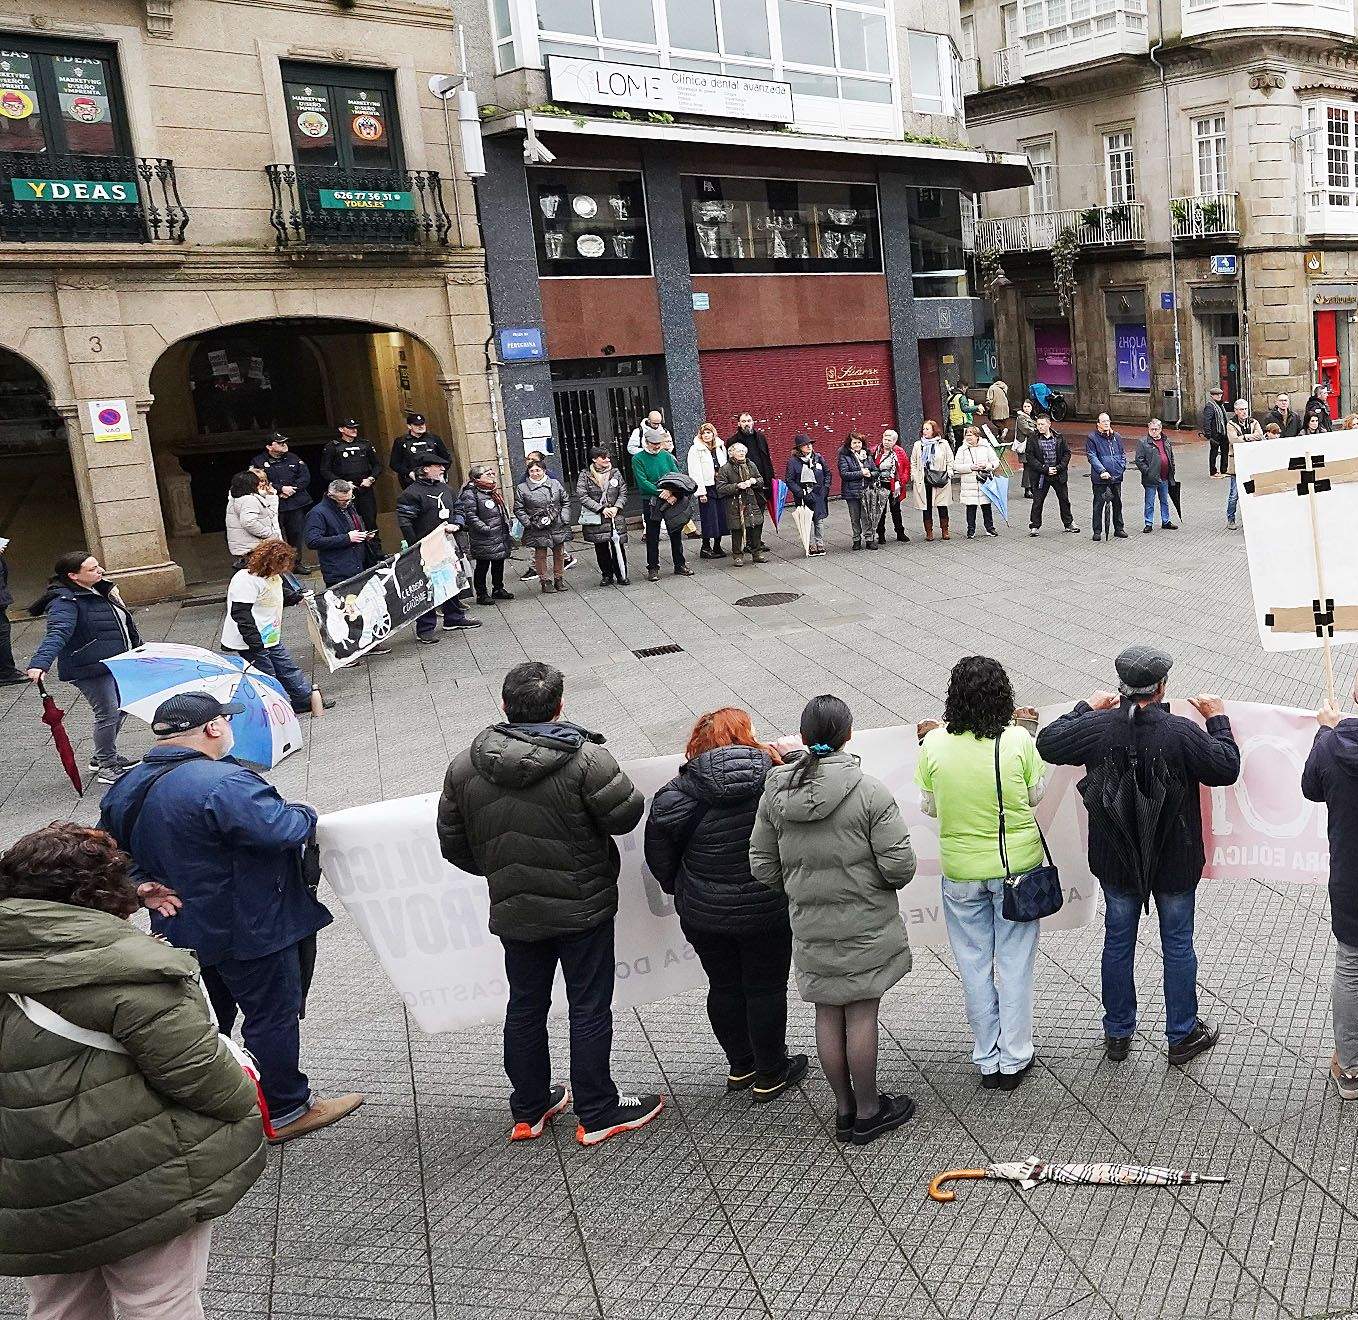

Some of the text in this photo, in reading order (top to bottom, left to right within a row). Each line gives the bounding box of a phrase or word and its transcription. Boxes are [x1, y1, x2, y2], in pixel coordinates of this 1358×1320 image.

[596, 71, 664, 100] LOME
[711, 78, 739, 90] dental
[30, 181, 127, 201] YDEAS
[333, 191, 353, 200] 626
[355, 192, 366, 200] 77
[367, 192, 380, 200] 36
[89, 335, 103, 353] 3
